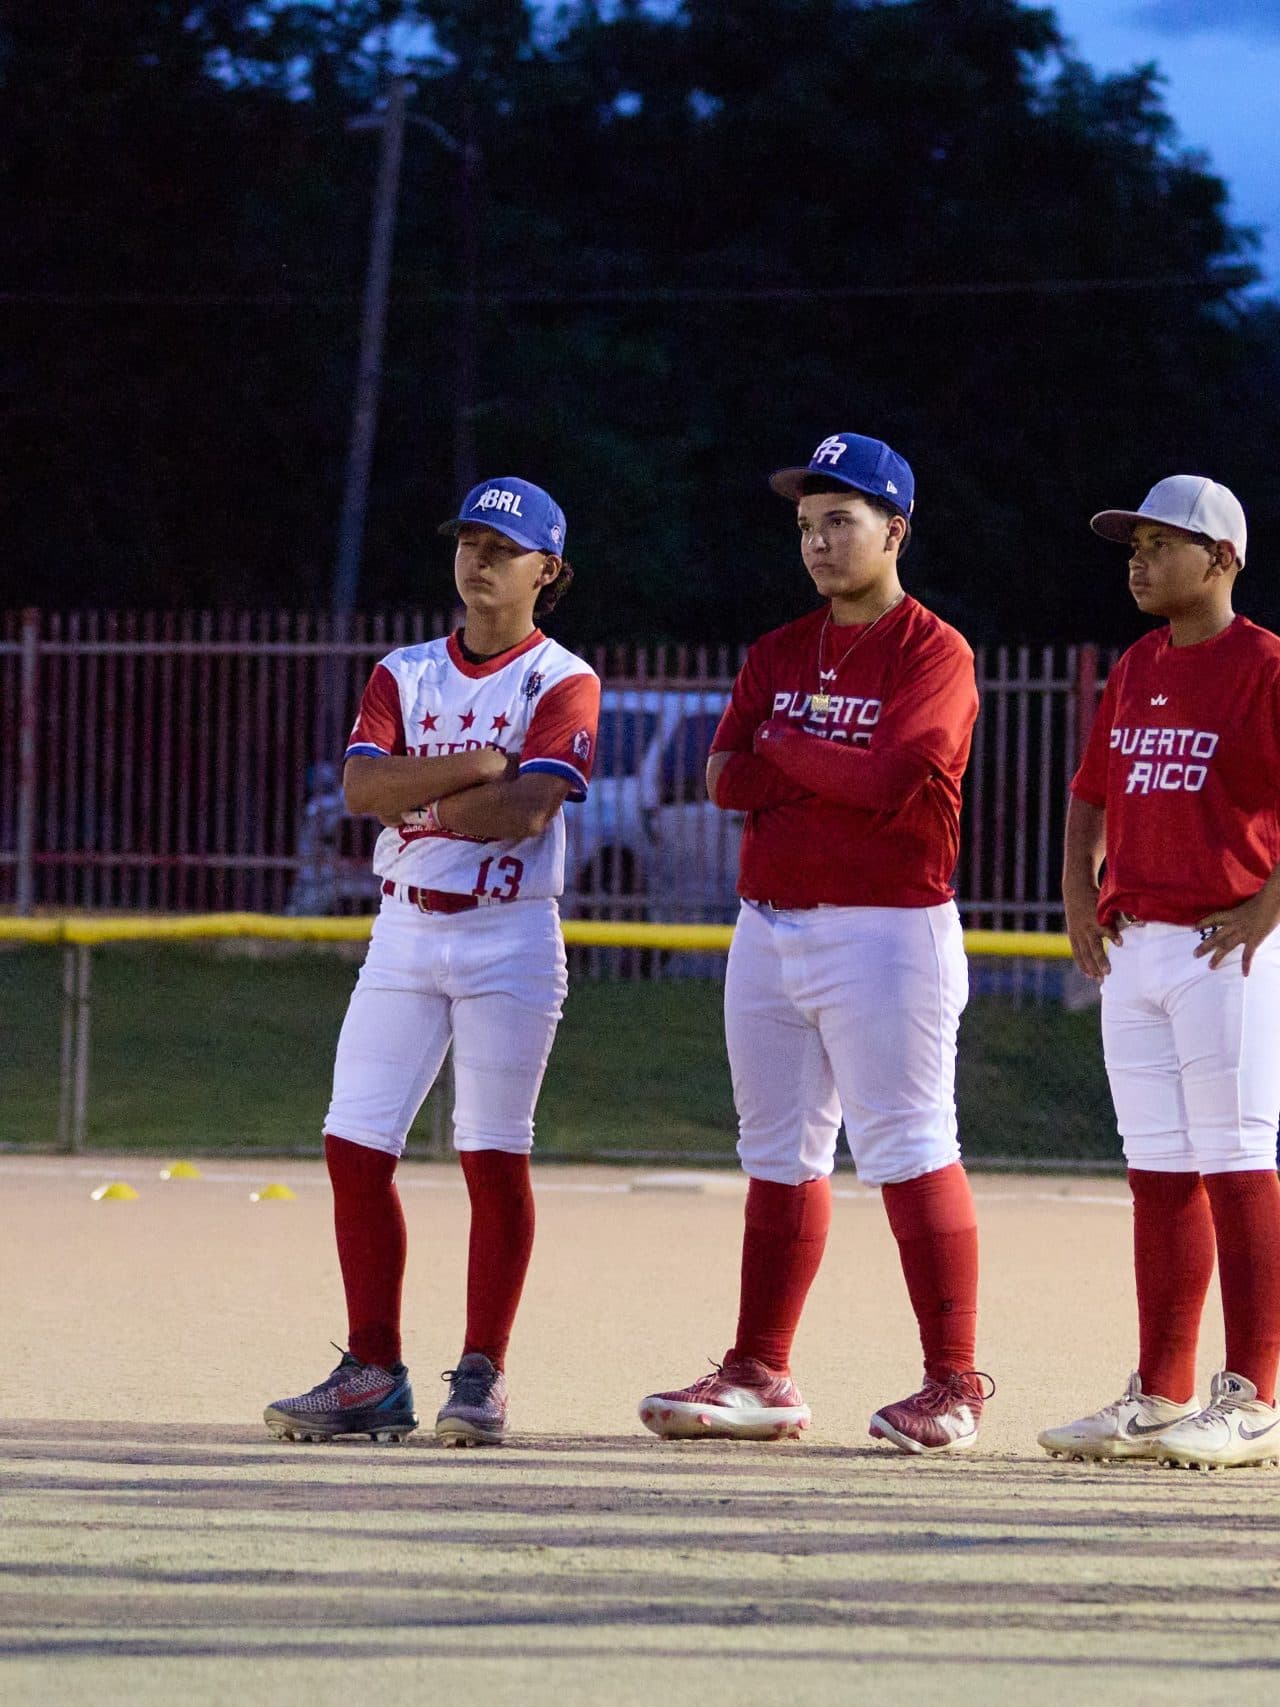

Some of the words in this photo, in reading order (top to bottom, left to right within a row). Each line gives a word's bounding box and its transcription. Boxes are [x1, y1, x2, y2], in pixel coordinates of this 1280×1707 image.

[1109, 728, 1219, 758] PUERTO
[1125, 762, 1207, 794] RICO
[472, 856, 523, 900] 13
